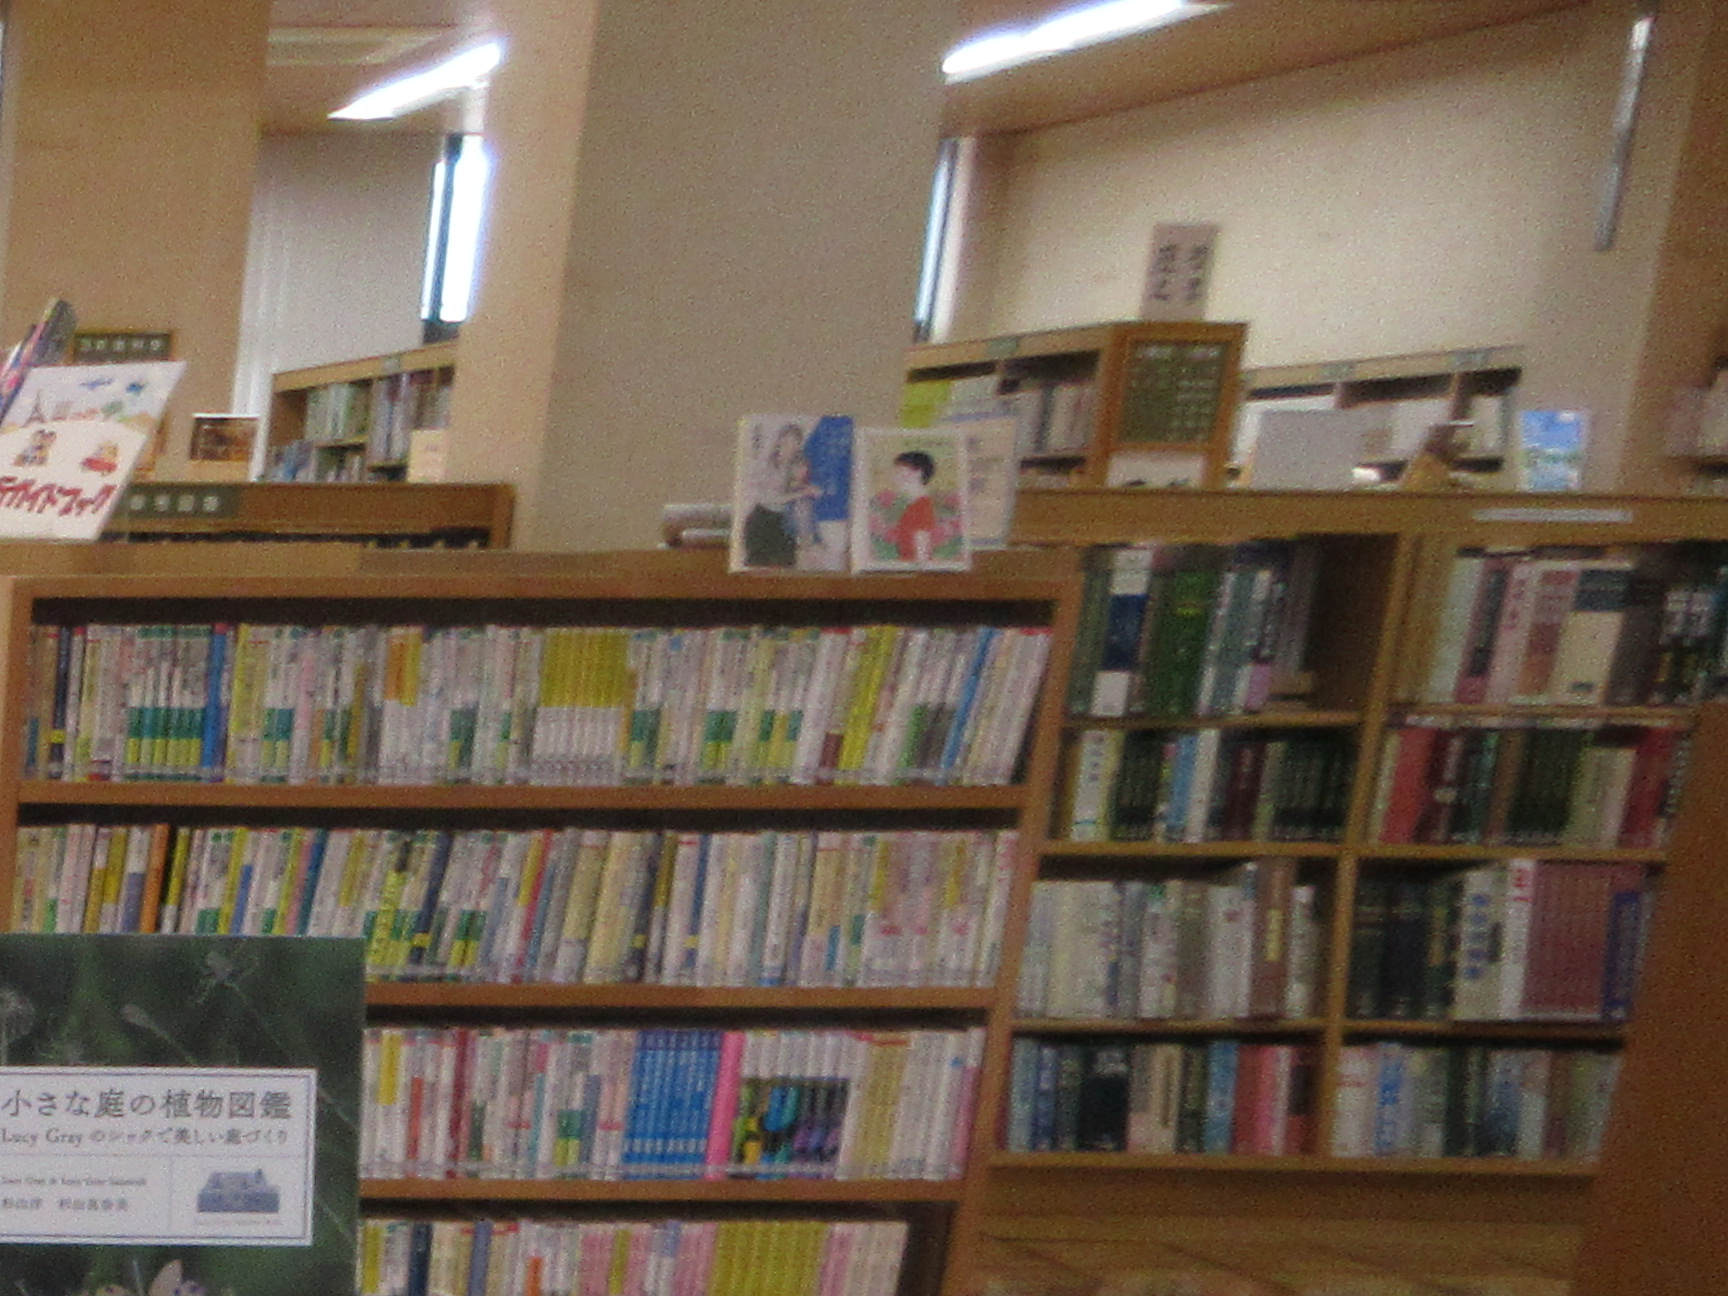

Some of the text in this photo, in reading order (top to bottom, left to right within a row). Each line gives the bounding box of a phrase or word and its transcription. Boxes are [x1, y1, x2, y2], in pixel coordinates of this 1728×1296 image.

[0, 1088, 293, 1120] 小さな庭の植物図鑑
[1, 1127, 38, 1148] Lucy
[45, 1128, 84, 1148] Gray
